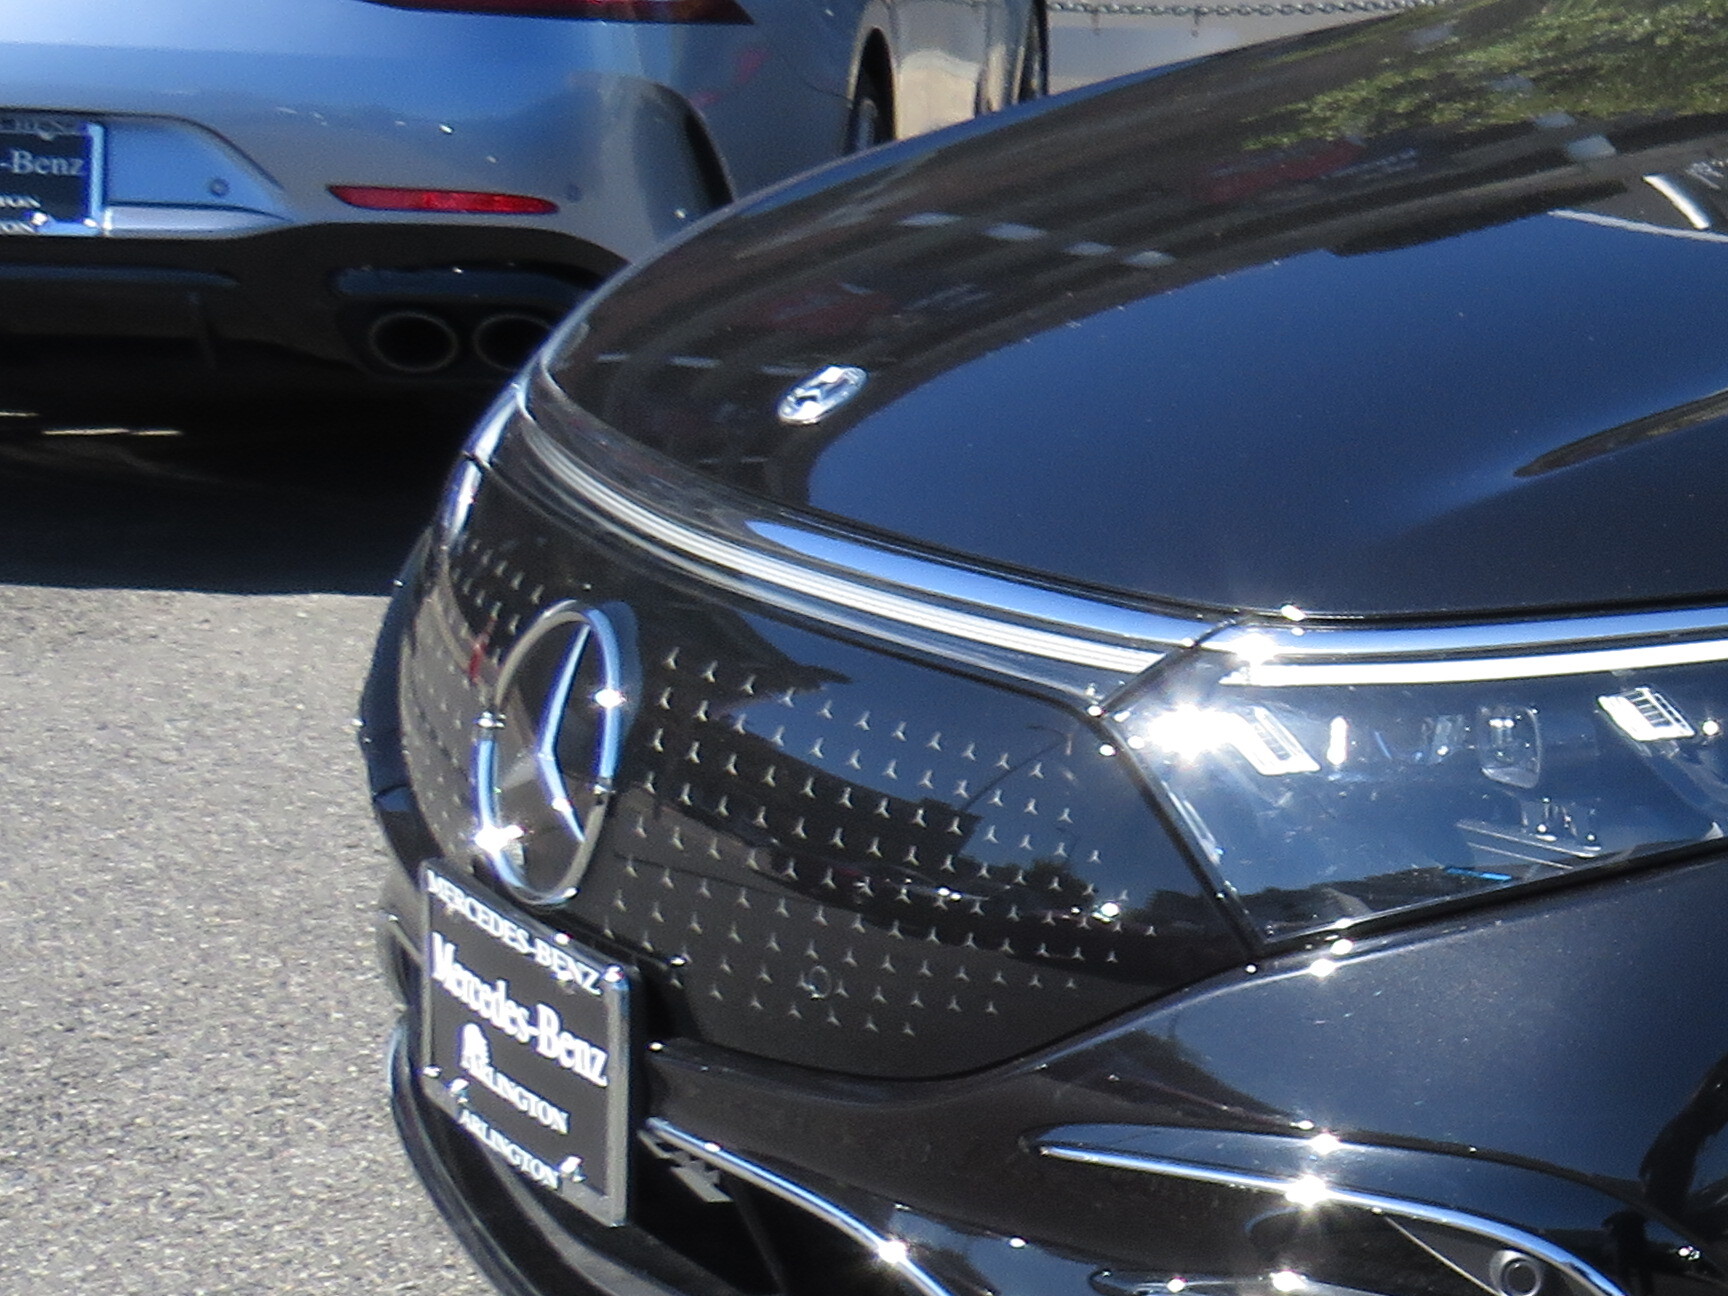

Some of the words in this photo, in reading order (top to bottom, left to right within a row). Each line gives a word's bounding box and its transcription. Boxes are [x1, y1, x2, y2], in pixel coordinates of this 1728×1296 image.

[428, 868, 602, 995] MERCEDES-BENZ
[432, 931, 609, 1086] Mercedes-Benz
[458, 1108, 560, 1191] ARLINGTON
